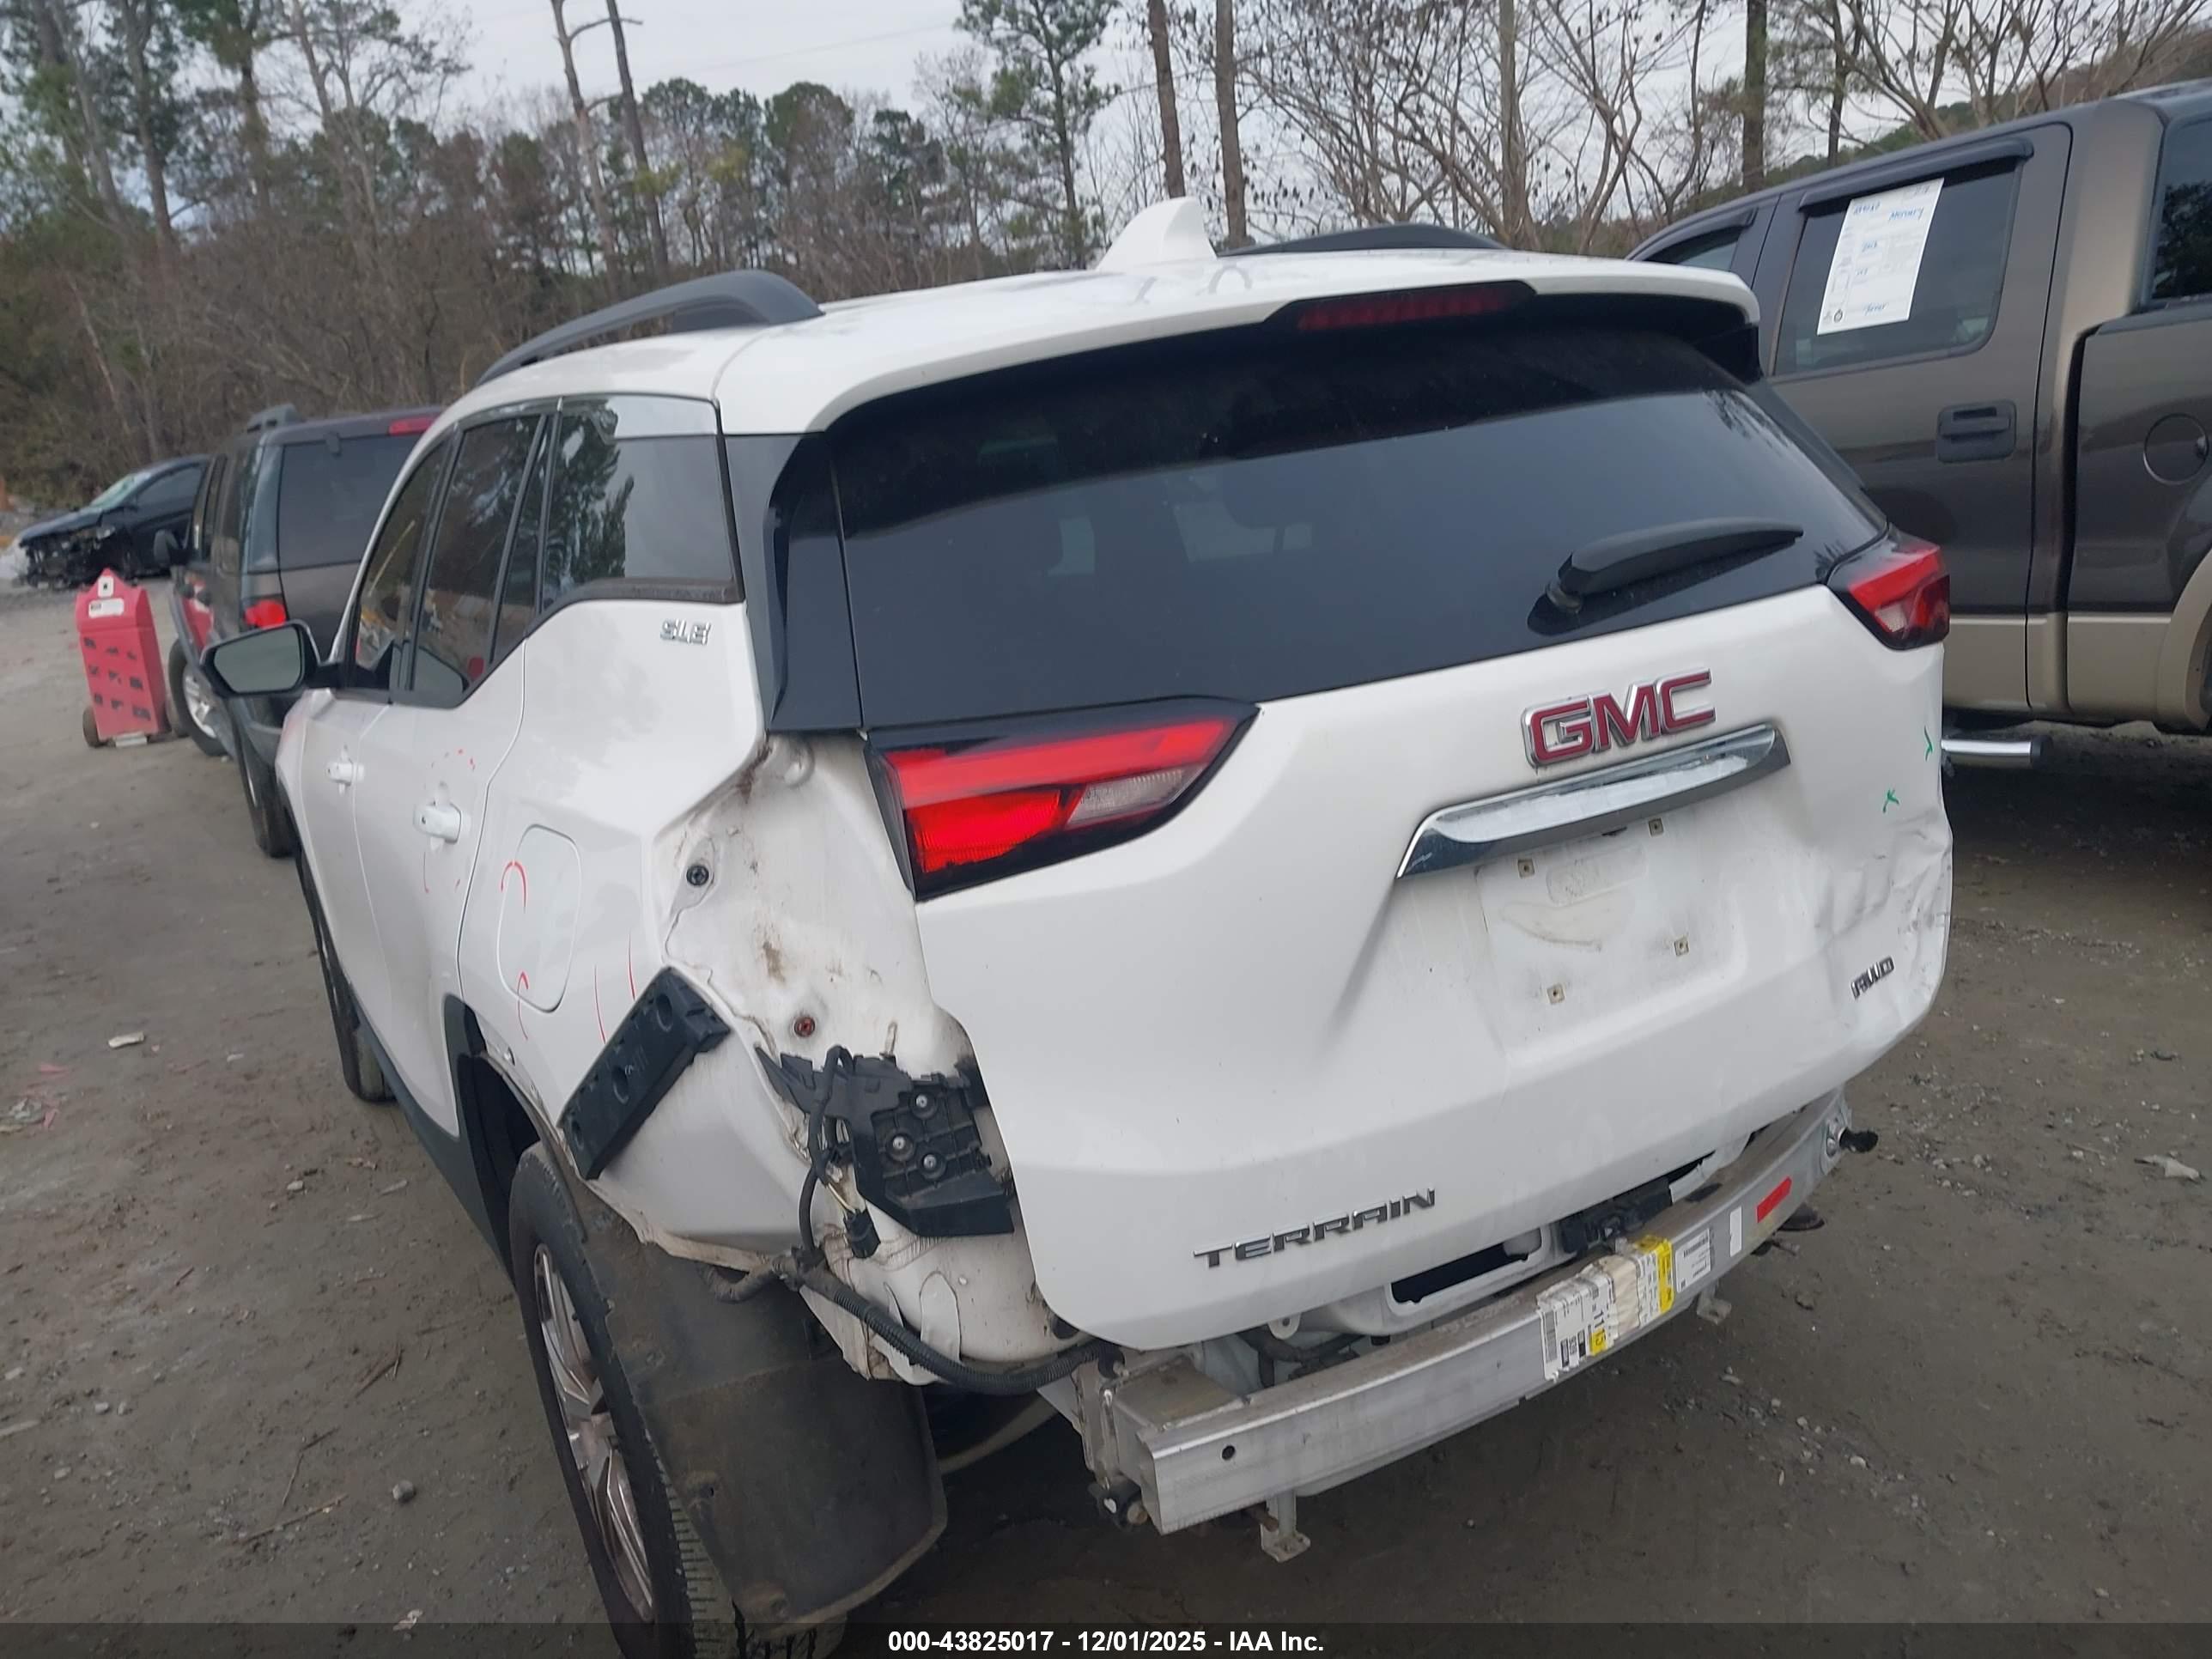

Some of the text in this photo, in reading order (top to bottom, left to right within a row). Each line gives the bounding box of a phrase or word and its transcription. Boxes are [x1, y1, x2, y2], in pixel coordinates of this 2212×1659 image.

[1521, 667, 1717, 768] GMC
[1850, 956, 1895, 1000] AWD
[1193, 1187, 1436, 1268] TERRAIN
